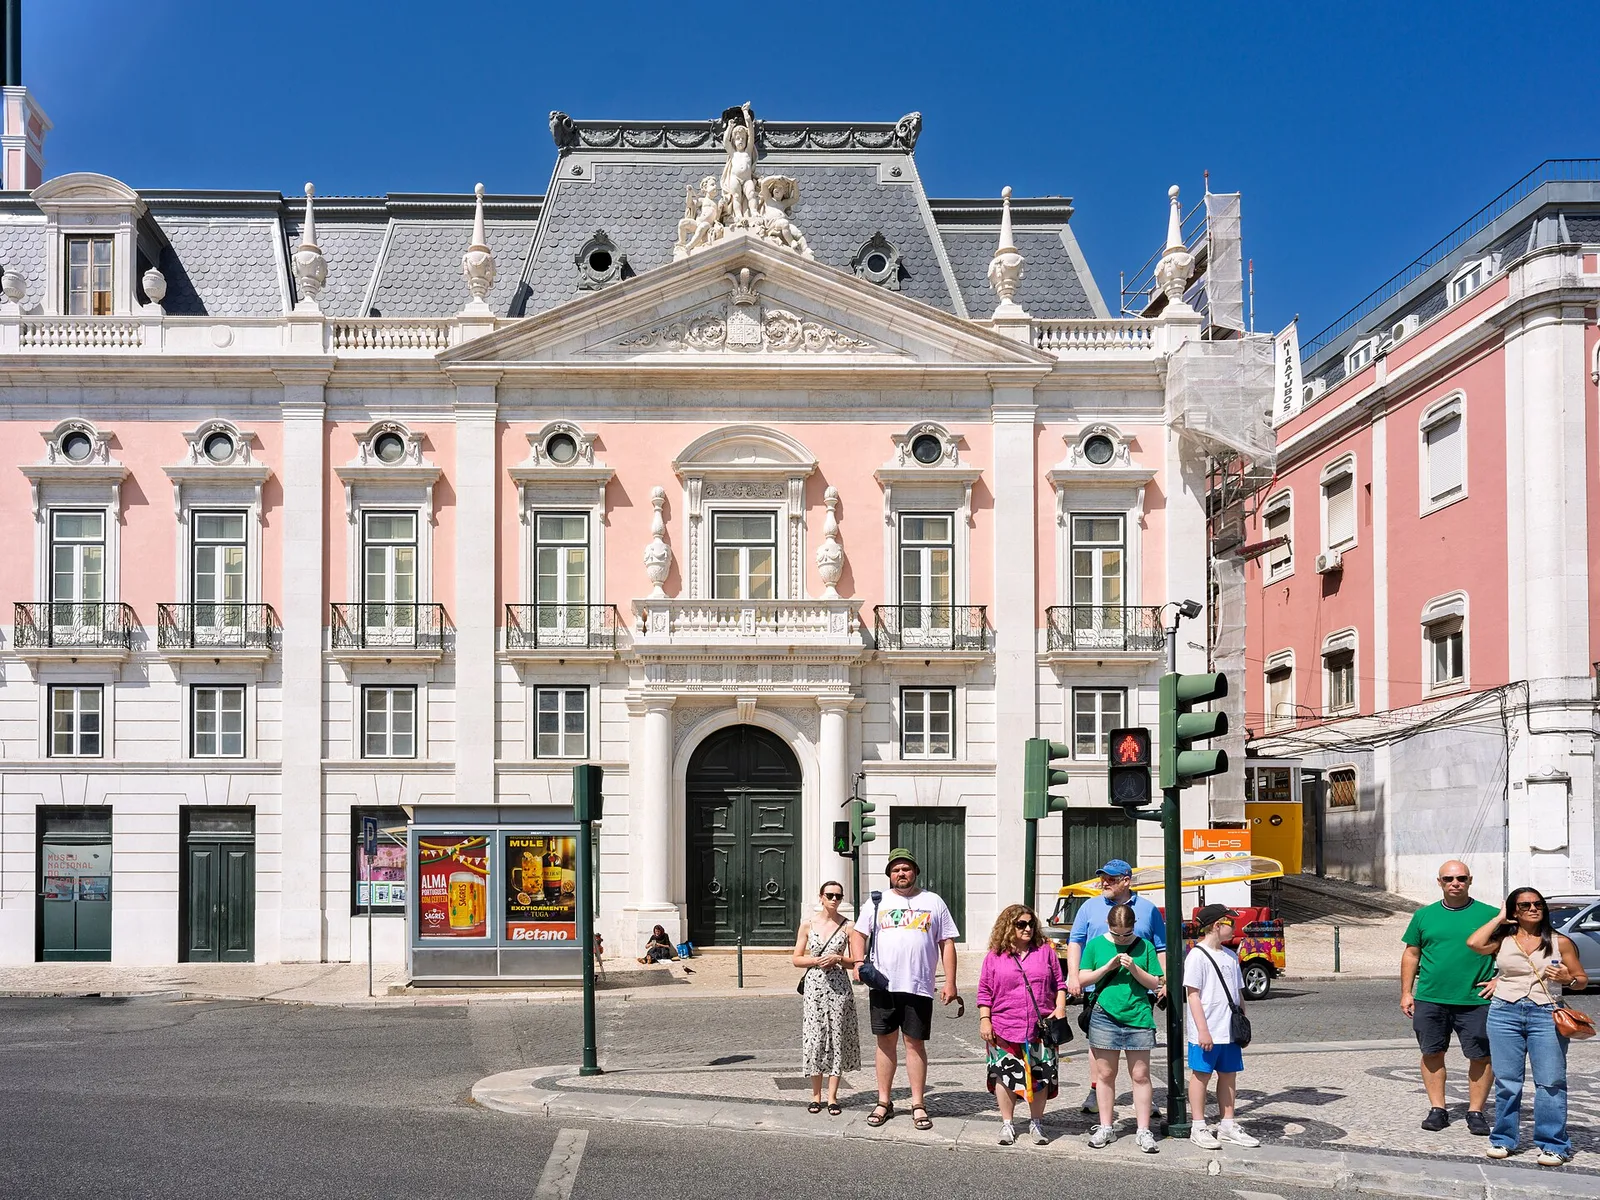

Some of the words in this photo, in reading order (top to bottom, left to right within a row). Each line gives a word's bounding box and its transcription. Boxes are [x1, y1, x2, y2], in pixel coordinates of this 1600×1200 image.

[1283, 339, 1293, 412] MIRATUBOS
[366, 822, 375, 852] P
[421, 874, 447, 888] ALMA
[459, 883, 467, 906] SAGRES
[424, 912, 445, 920] SAGRES
[512, 927, 568, 940] Betano
